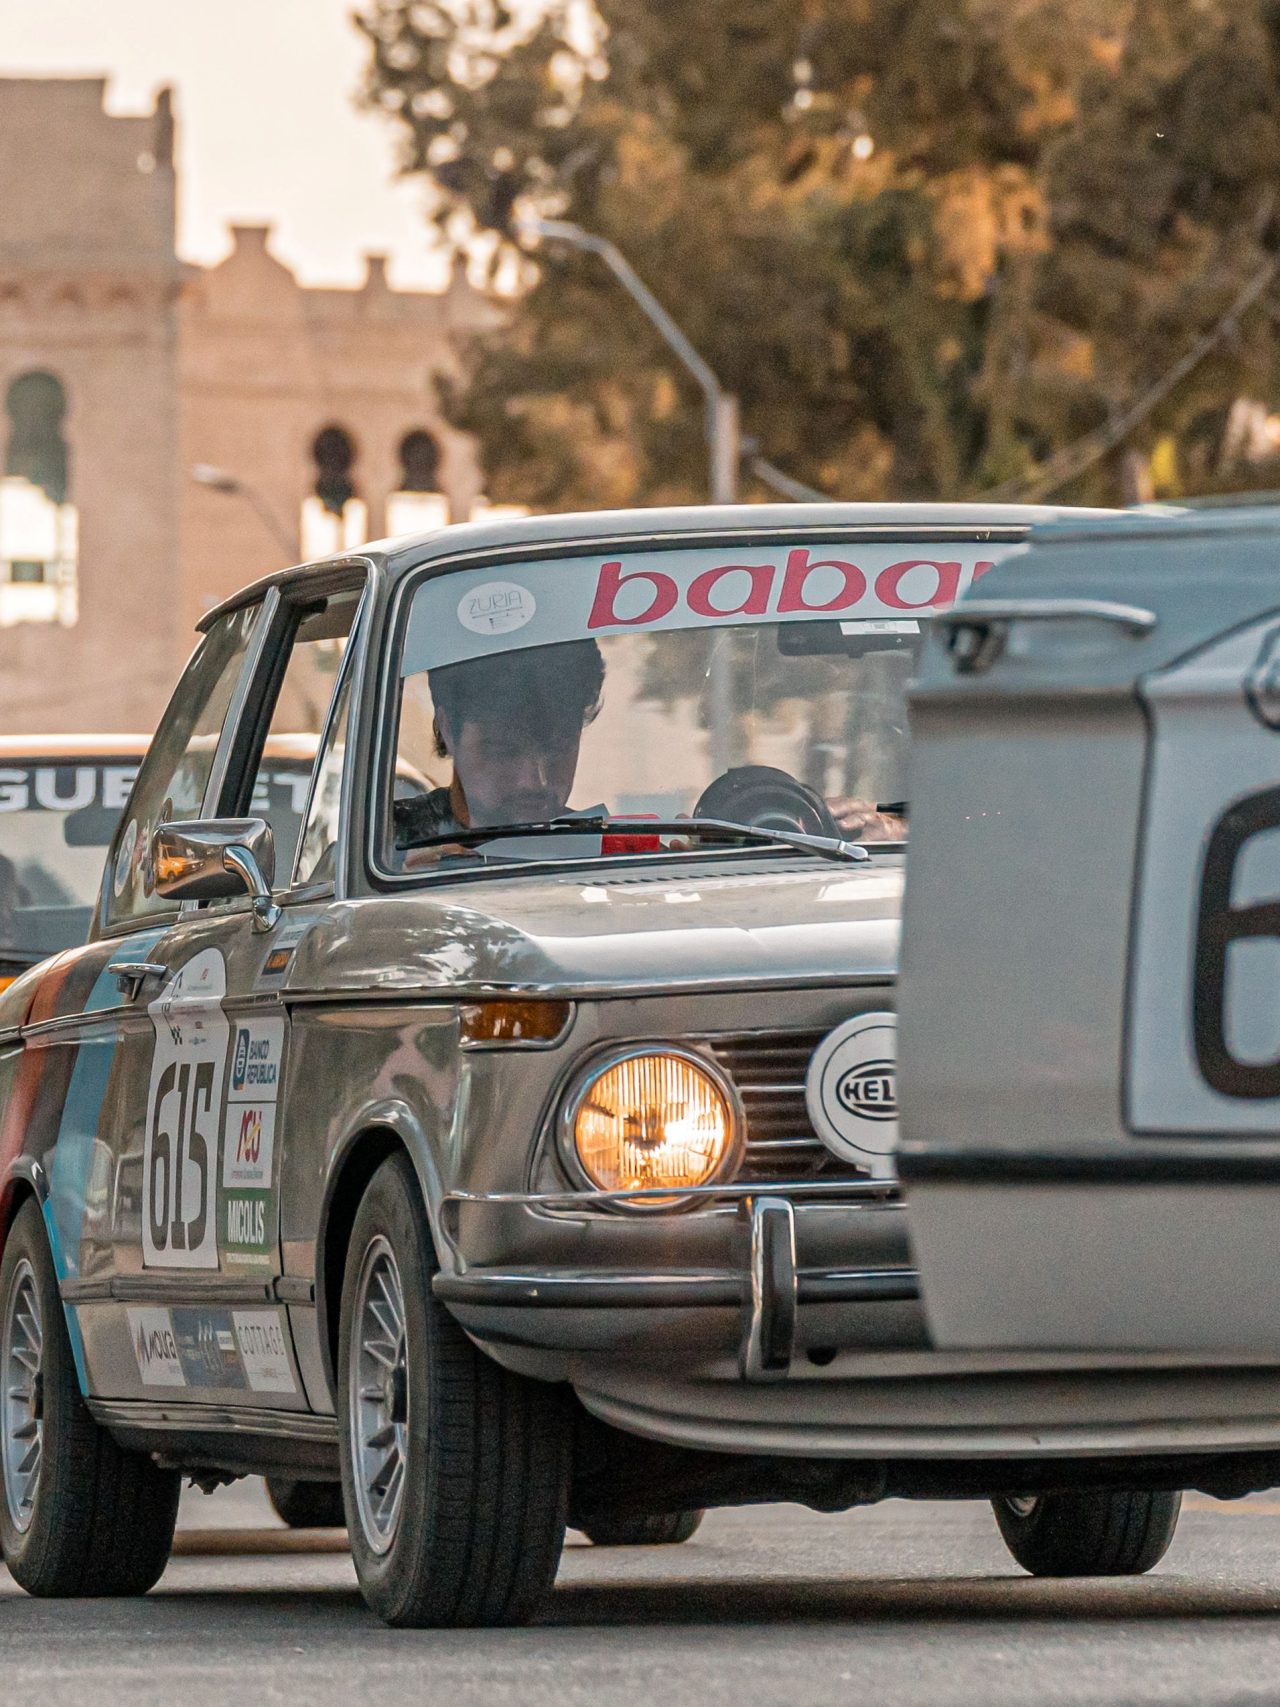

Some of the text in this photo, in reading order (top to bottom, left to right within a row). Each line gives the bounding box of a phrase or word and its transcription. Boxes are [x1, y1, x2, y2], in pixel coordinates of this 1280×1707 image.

[249, 1039, 270, 1060] BANCO
[150, 1061, 215, 1252] 615
[228, 1200, 265, 1245] MICOLIS
[238, 1326, 285, 1356] COTTAGE
